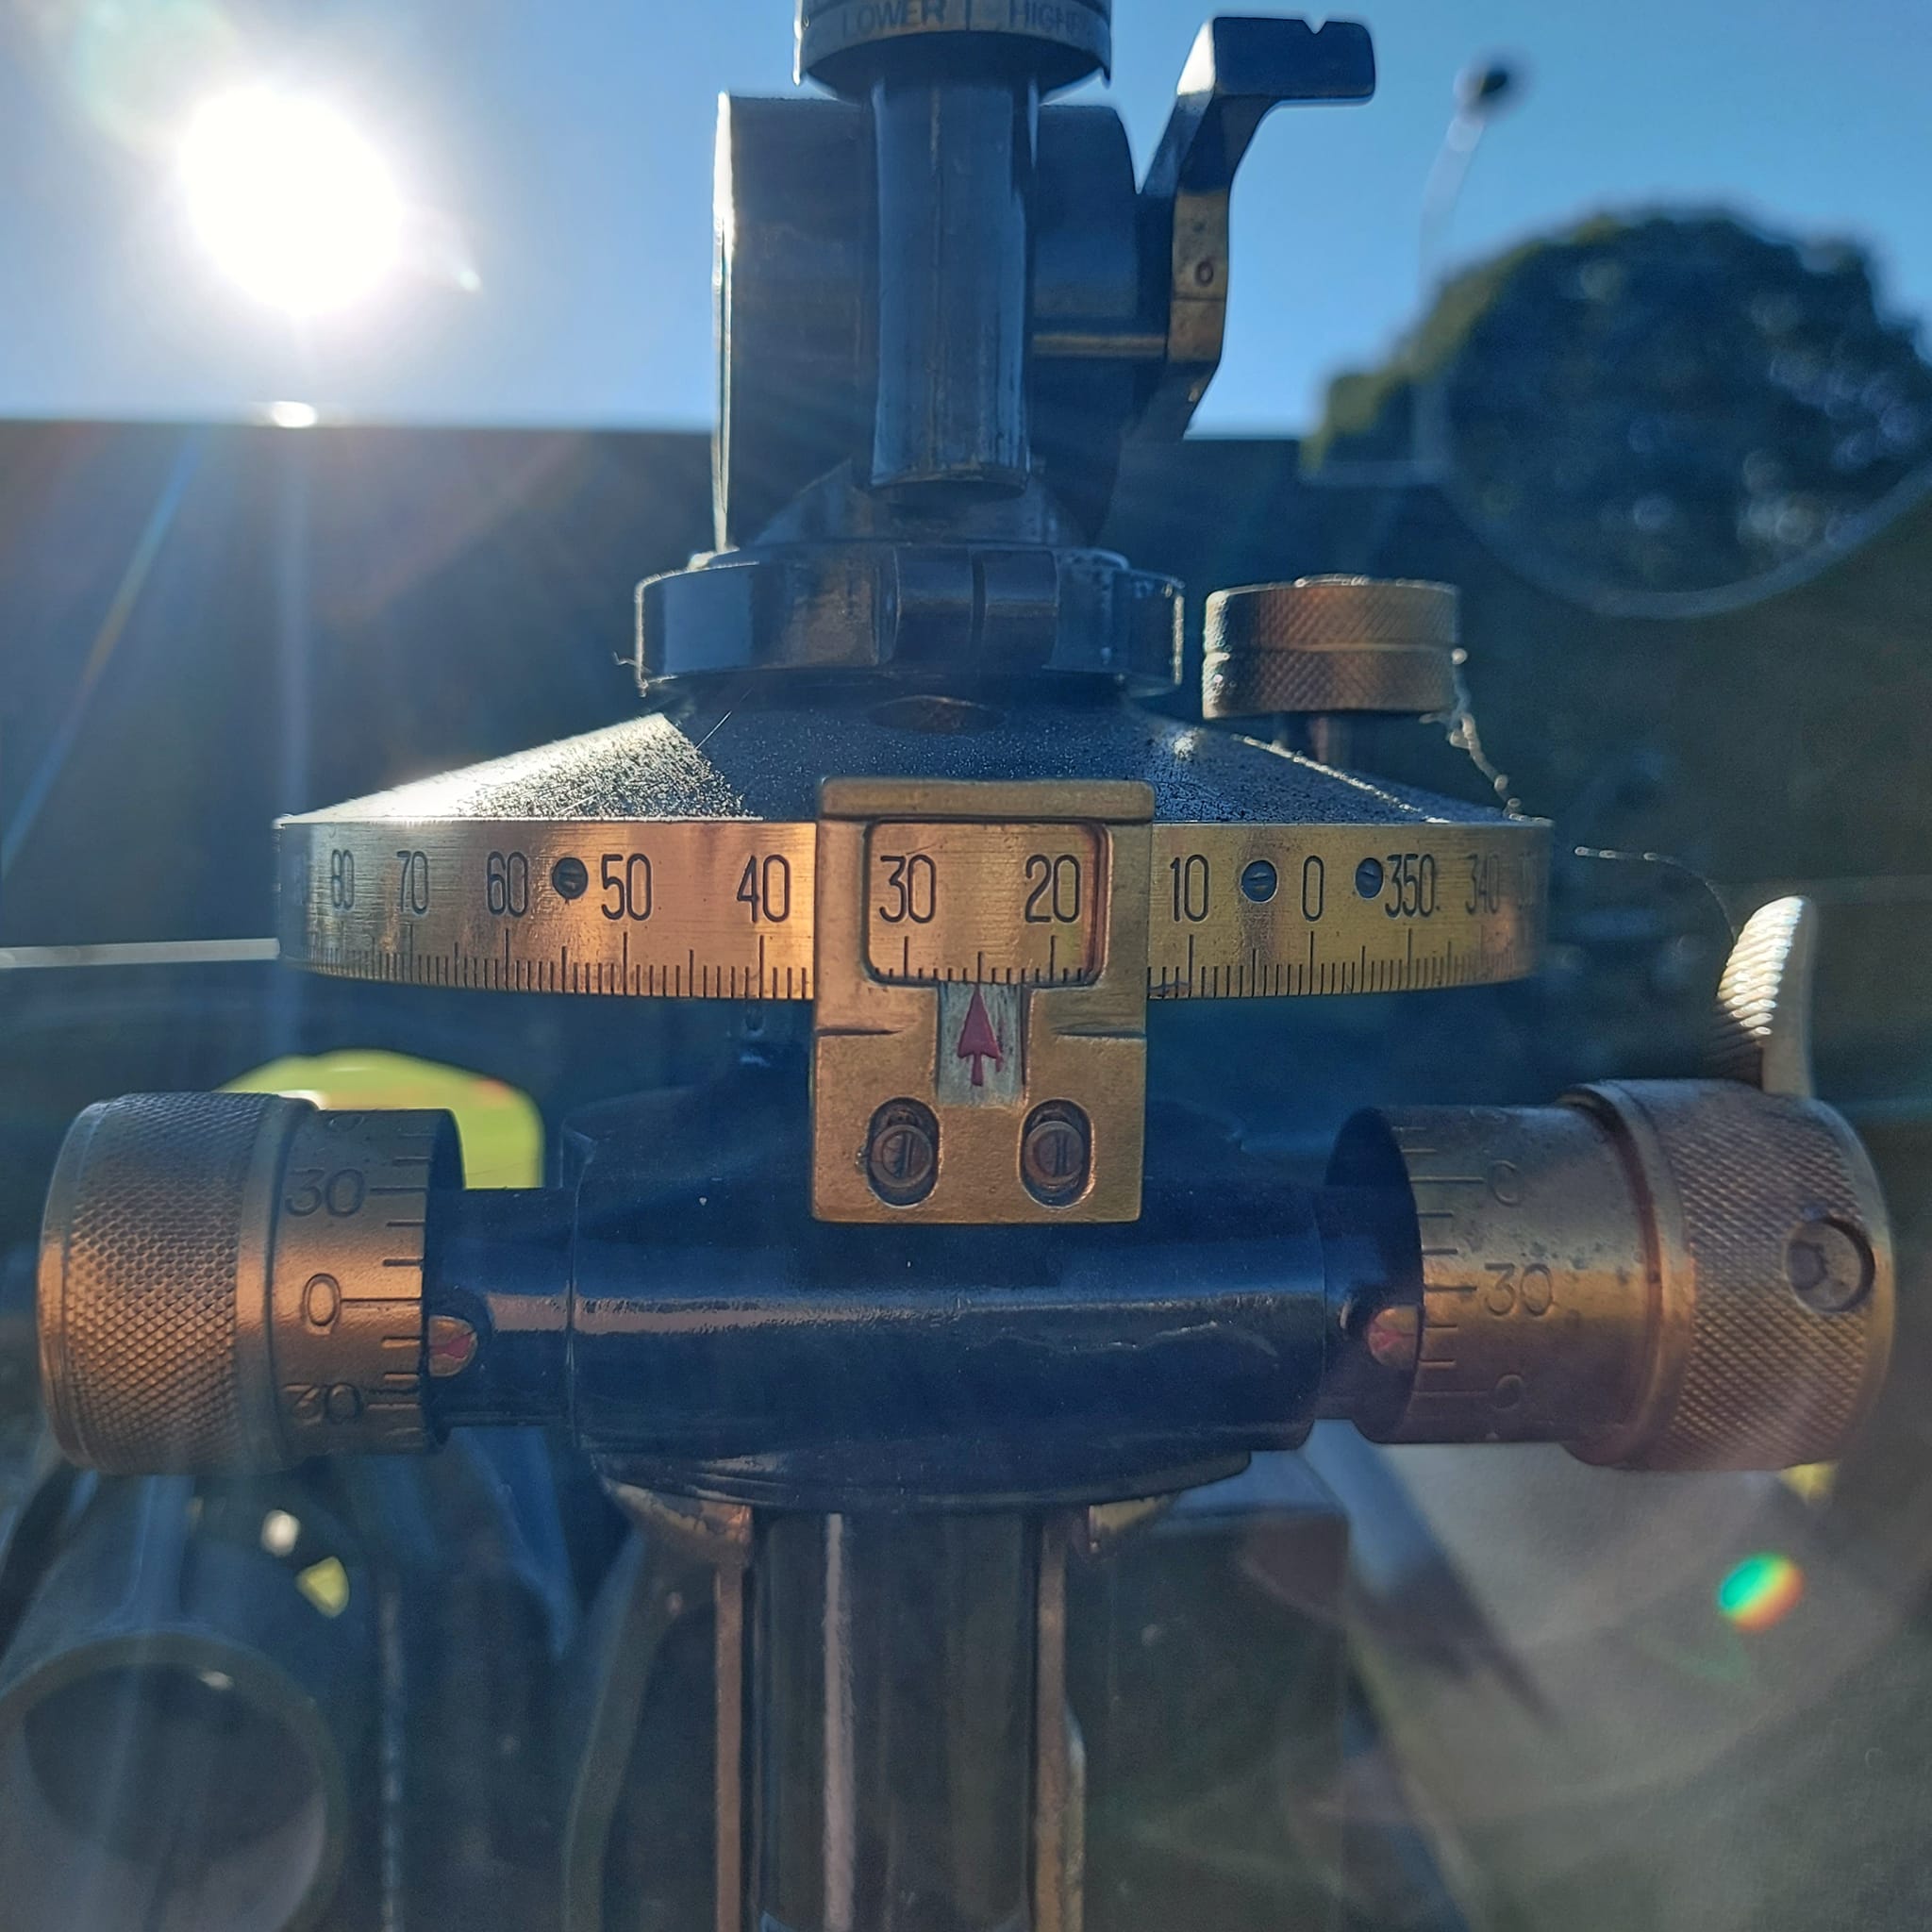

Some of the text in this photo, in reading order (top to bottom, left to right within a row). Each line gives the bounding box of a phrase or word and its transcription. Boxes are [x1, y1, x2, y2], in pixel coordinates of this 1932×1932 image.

[395, 849, 429, 916] 70
[487, 850, 528, 918] 60
[600, 853, 652, 922] 50
[736, 854, 791, 923] 40
[878, 854, 937, 924] 30
[1024, 854, 1081, 924] 20
[1170, 854, 1209, 923] 10
[1301, 855, 1324, 922] 0
[1384, 853, 1437, 918] 350
[285, 1168, 367, 1218] 30
[302, 1272, 341, 1328] 0
[1483, 1262, 1555, 1317] 30
[285, 1382, 362, 1426] 30
